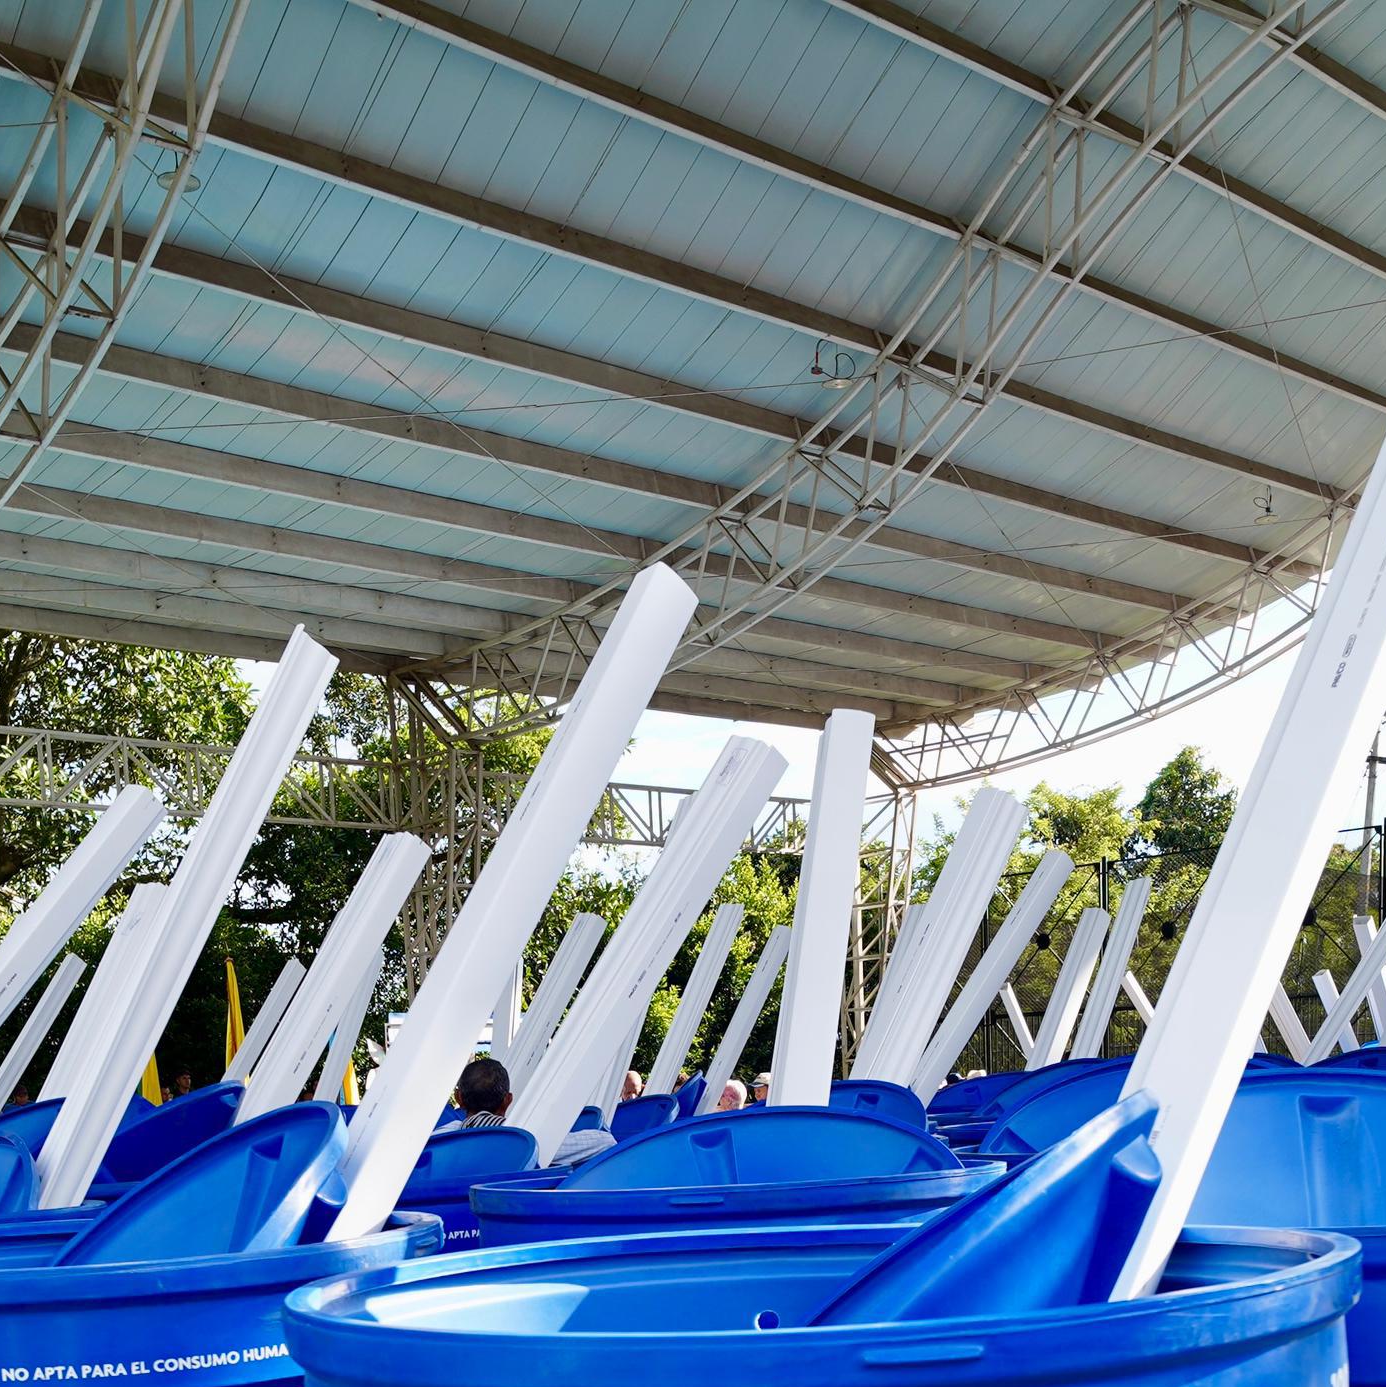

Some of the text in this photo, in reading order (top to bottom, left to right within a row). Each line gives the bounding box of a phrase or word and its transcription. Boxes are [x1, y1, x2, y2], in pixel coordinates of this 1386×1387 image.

[448, 1230, 470, 1240] APTA
[1, 1367, 29, 1381] NO
[33, 1364, 79, 1381] APTA
[81, 1361, 128, 1379] PARA
[130, 1360, 151, 1375] EL
[153, 1350, 241, 1373] CONSUMO
[242, 1343, 290, 1363] HUMA
